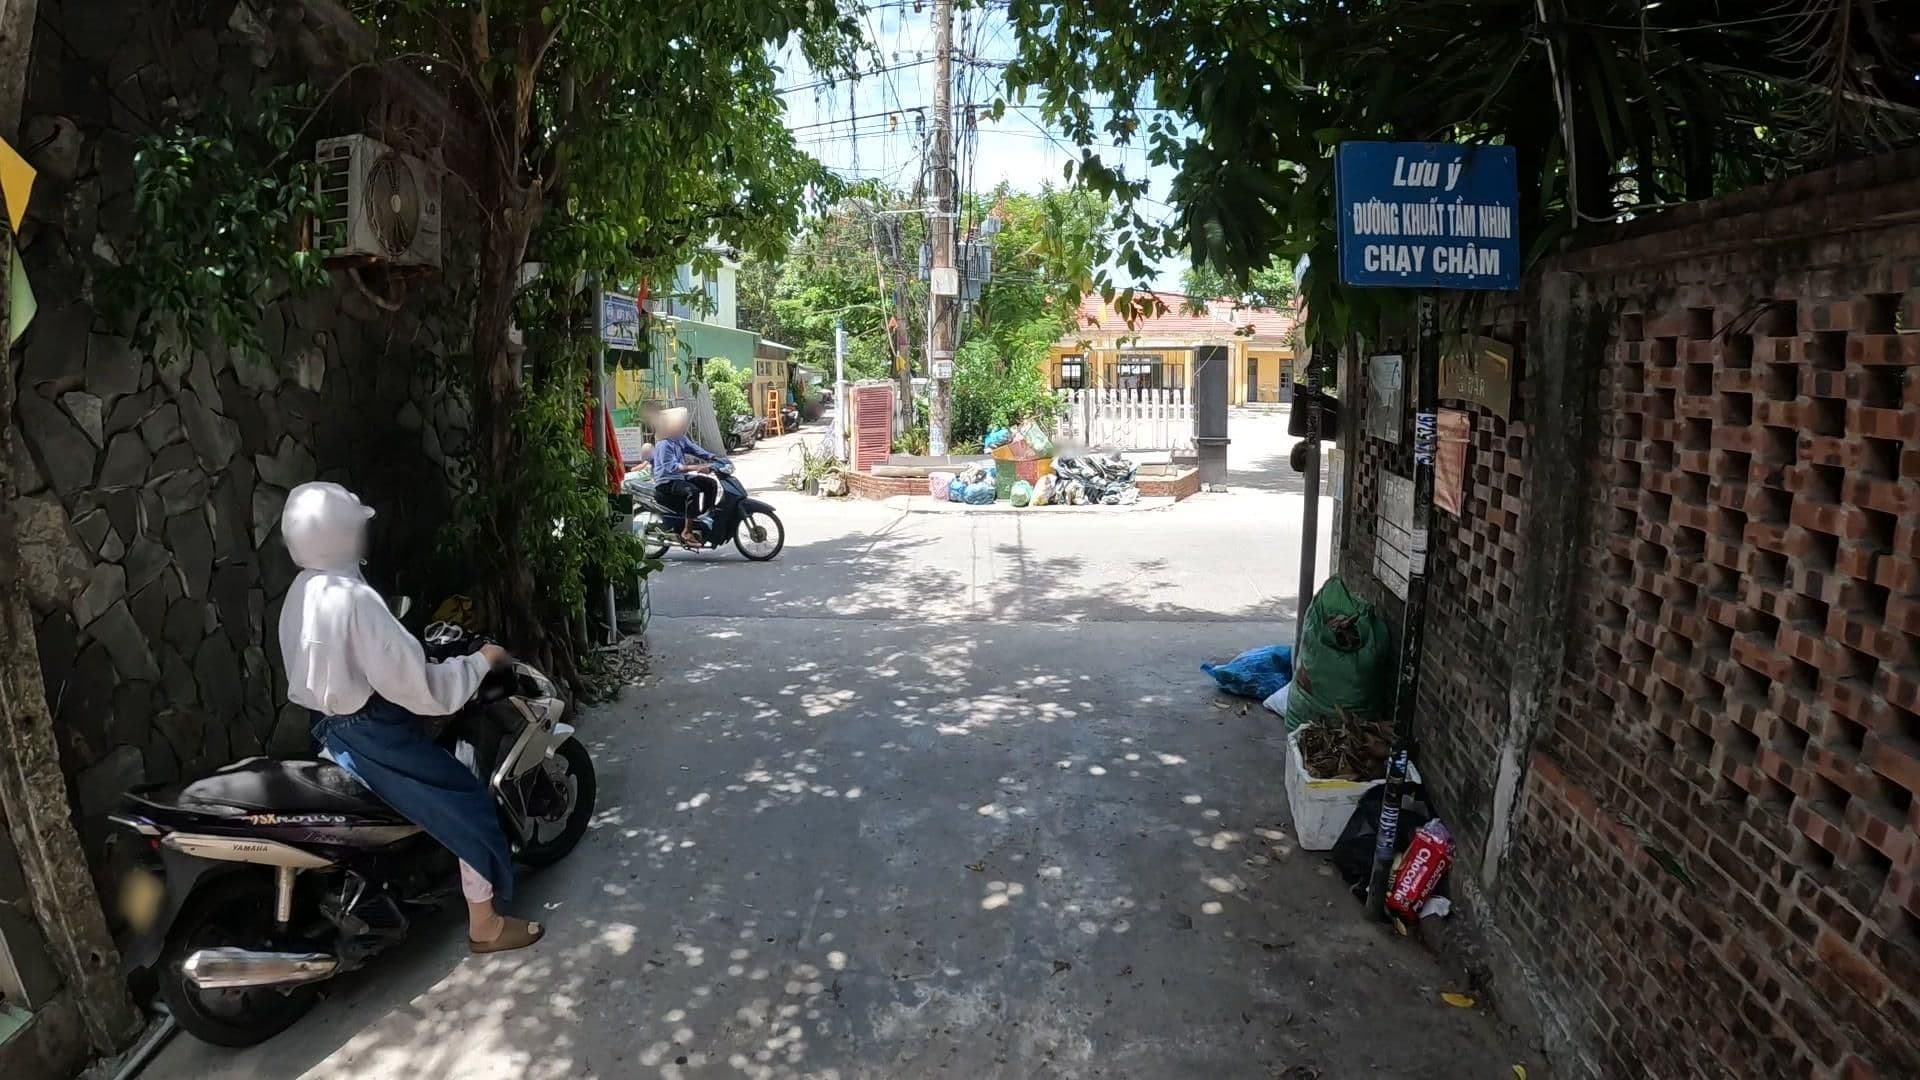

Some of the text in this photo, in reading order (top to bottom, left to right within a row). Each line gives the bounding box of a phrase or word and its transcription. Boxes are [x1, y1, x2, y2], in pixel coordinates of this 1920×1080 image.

[1393, 156, 1463, 191] Lưu ý
[1353, 195, 1511, 239] ĐƯỜNG KHUẤT TẦM NHÌN
[1364, 242, 1500, 279] CHẠY CHẬM
[232, 843, 268, 852] YAMAHA
